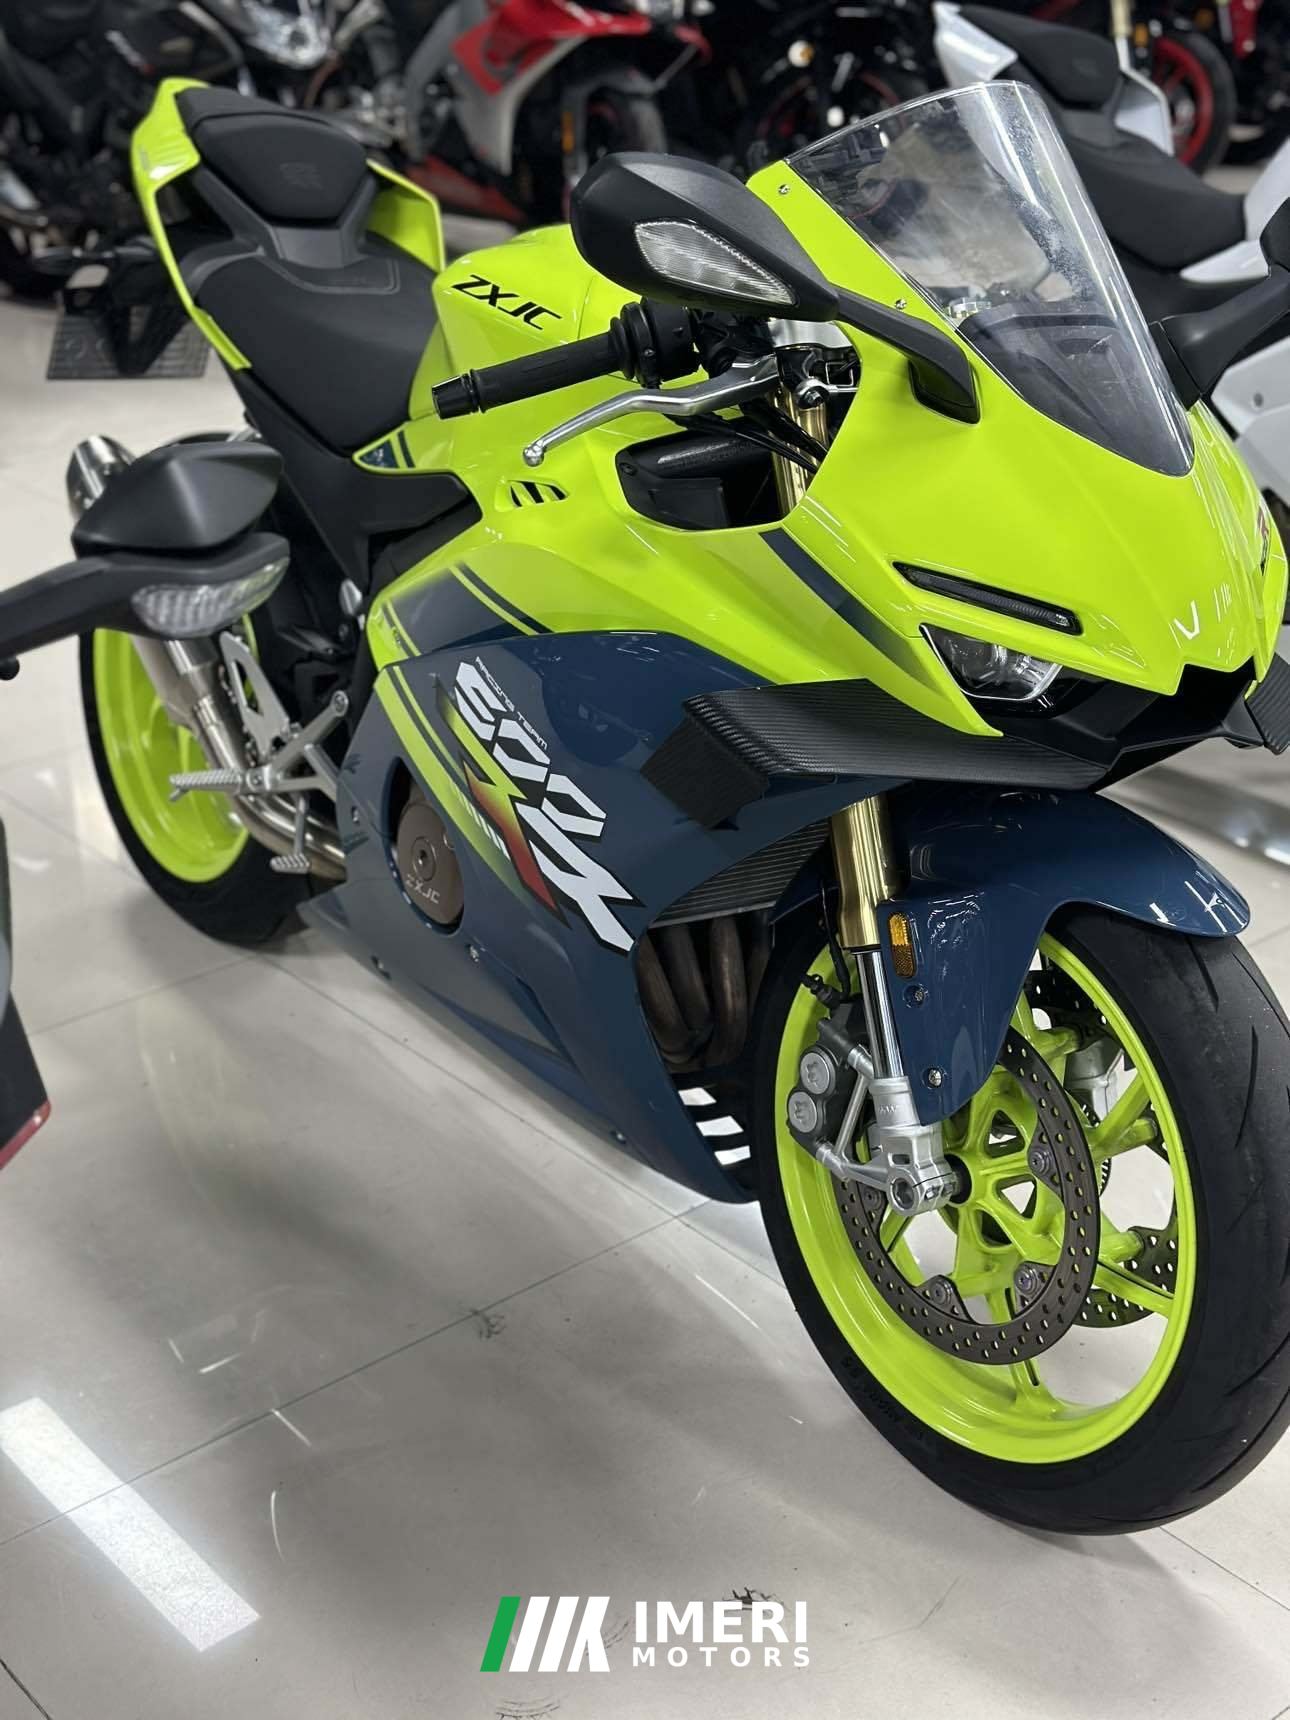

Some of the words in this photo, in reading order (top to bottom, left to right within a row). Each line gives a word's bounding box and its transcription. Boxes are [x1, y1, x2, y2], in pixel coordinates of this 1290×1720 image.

[452, 274, 562, 330] ZXJC
[475, 656, 515, 712] RACING
[517, 711, 548, 750] TEAM
